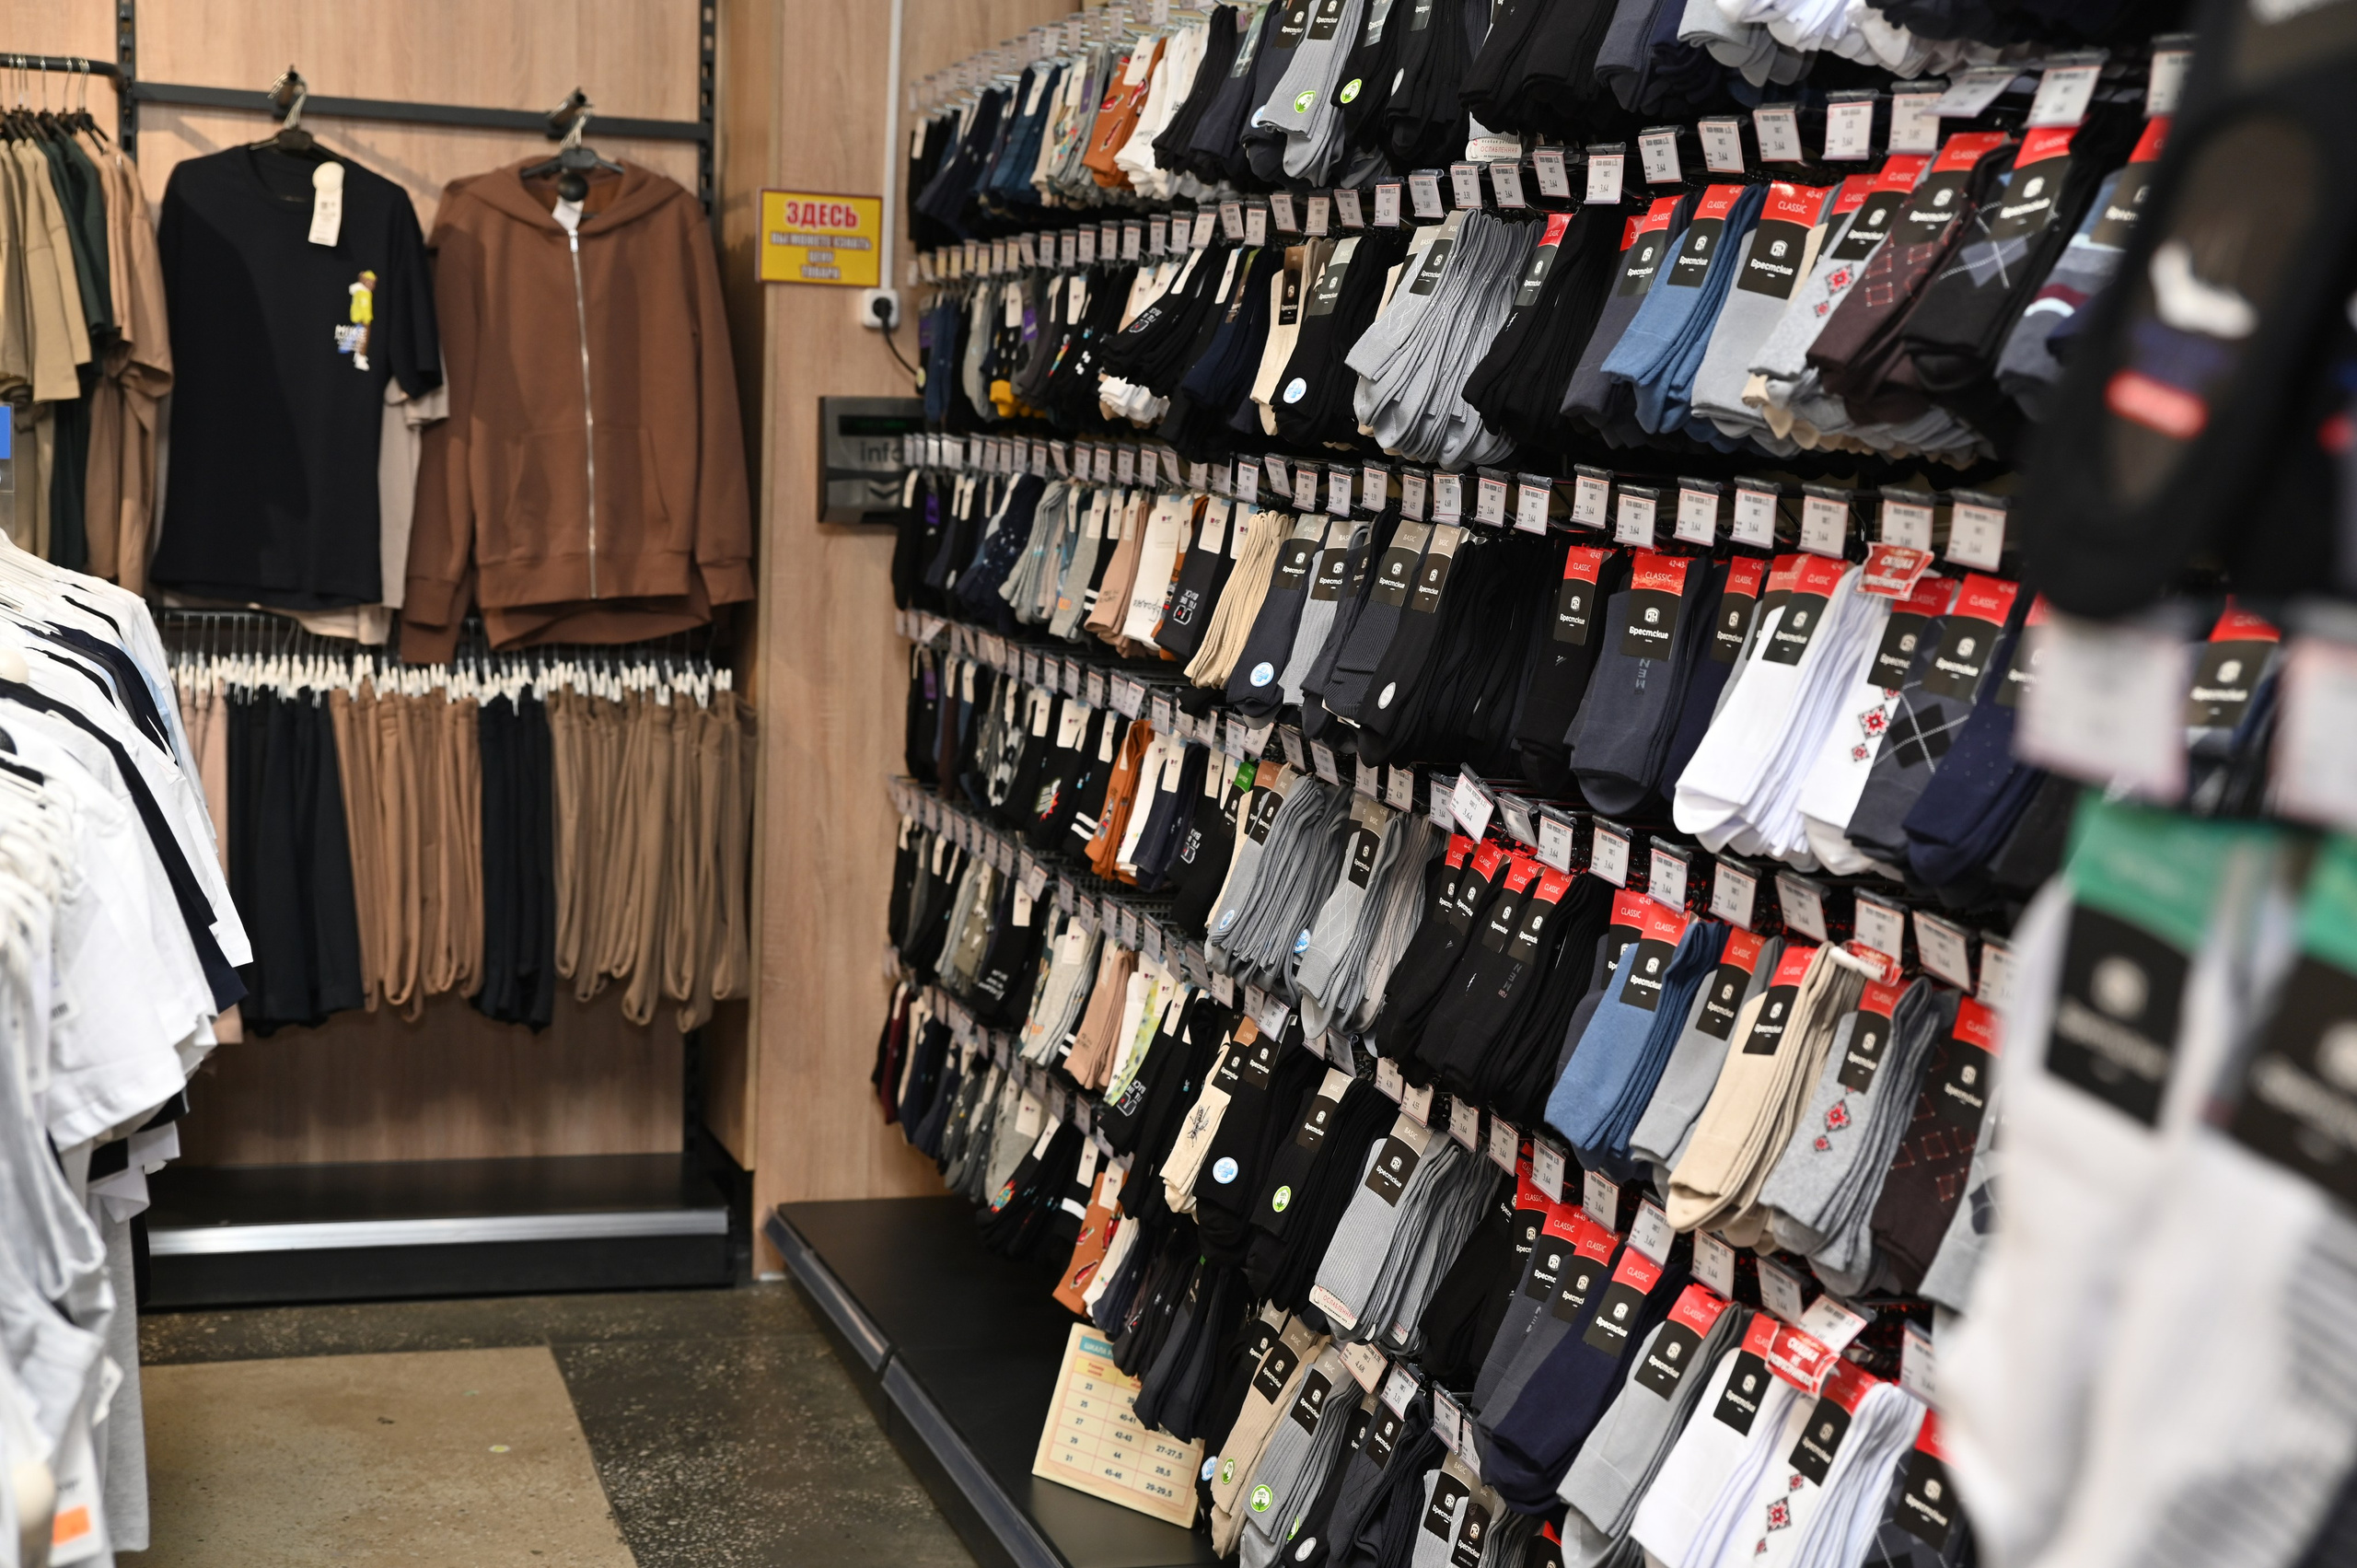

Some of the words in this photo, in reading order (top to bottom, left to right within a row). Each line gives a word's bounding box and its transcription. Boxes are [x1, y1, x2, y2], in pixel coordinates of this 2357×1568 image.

[1480, 145, 1518, 154] ОСЛАБЛЕННАЯ
[1718, 152, 1728, 162] 3.64
[1656, 163, 1666, 173] 3.64
[1805, 190, 1824, 200] 40-41
[1707, 201, 1728, 209] CLASSIC
[1778, 200, 1808, 215] CLASSIC
[786, 201, 858, 228] ЗДЕСЬ
[1652, 212, 1671, 222] CLASSIC
[1750, 259, 1794, 276] Брестские
[1585, 505, 1595, 515] 3.64
[1527, 514, 1536, 523] 3.64
[1629, 526, 1640, 536] 3.64
[1402, 534, 1418, 542] BASIC
[1438, 539, 1449, 547] BASIC
[1573, 562, 1592, 573] CLASSIC
[1379, 576, 1406, 589] Брестские
[1645, 571, 1673, 582] CLASSIC
[1735, 575, 1753, 586] CLASSIC
[1806, 573, 1831, 586] CLASSIC
[1968, 595, 2000, 610] CLASSIC
[1560, 613, 1585, 625] Брестские
[1629, 625, 1669, 640] Брестские
[1463, 808, 1473, 821] 3.64
[1550, 849, 1559, 858] 3.64
[1479, 855, 1492, 869] CLASSIC
[1604, 860, 1614, 871] 3.64
[1513, 874, 1527, 886] CLASSIC
[1544, 883, 1561, 895] CLASSIC
[1662, 884, 1672, 895] 3.64
[1620, 907, 1642, 919] CLASSIC
[1655, 922, 1677, 934] CLASSIC
[1731, 946, 1751, 960] CLASSIC
[1782, 966, 1804, 976] CLASSIC
[1403, 1126, 1419, 1141] BASIC
[1459, 1123, 1468, 1134] 3.64
[1499, 1147, 1507, 1159] 3.64
[1376, 1165, 1402, 1189] Брестские
[1542, 1173, 1550, 1185] 3.64
[1524, 1192, 1543, 1202] CLASSIC
[1595, 1202, 1604, 1214] 3.64
[1573, 1212, 1586, 1222] 44-45
[1553, 1219, 1575, 1233] CLASSIC
[1586, 1239, 1607, 1253] CLASSIC
[1643, 1235, 1656, 1249] 3.64
[1535, 1269, 1557, 1283] Брестс
[1627, 1266, 1650, 1283] CLASSIC
[1323, 1295, 1355, 1320] ОСЛАБЛЕННАЯ
[1683, 1305, 1706, 1323] CLASSIC
[1291, 1334, 1301, 1346] BASIC
[1324, 1361, 1335, 1374] BASIC
[1355, 1361, 1365, 1374] 4.68
[1119, 1413, 1137, 1424] 40-41
[1070, 1436, 1078, 1445] 29
[1115, 1431, 1132, 1443] 42-43
[1156, 1445, 1183, 1460] 27-27,5
[1155, 1466, 1171, 1477] 28,5
[1453, 1461, 1467, 1475] BASIC
[1146, 1482, 1173, 1498] 29-29,5
[1457, 1539, 1480, 1559] Брестские
